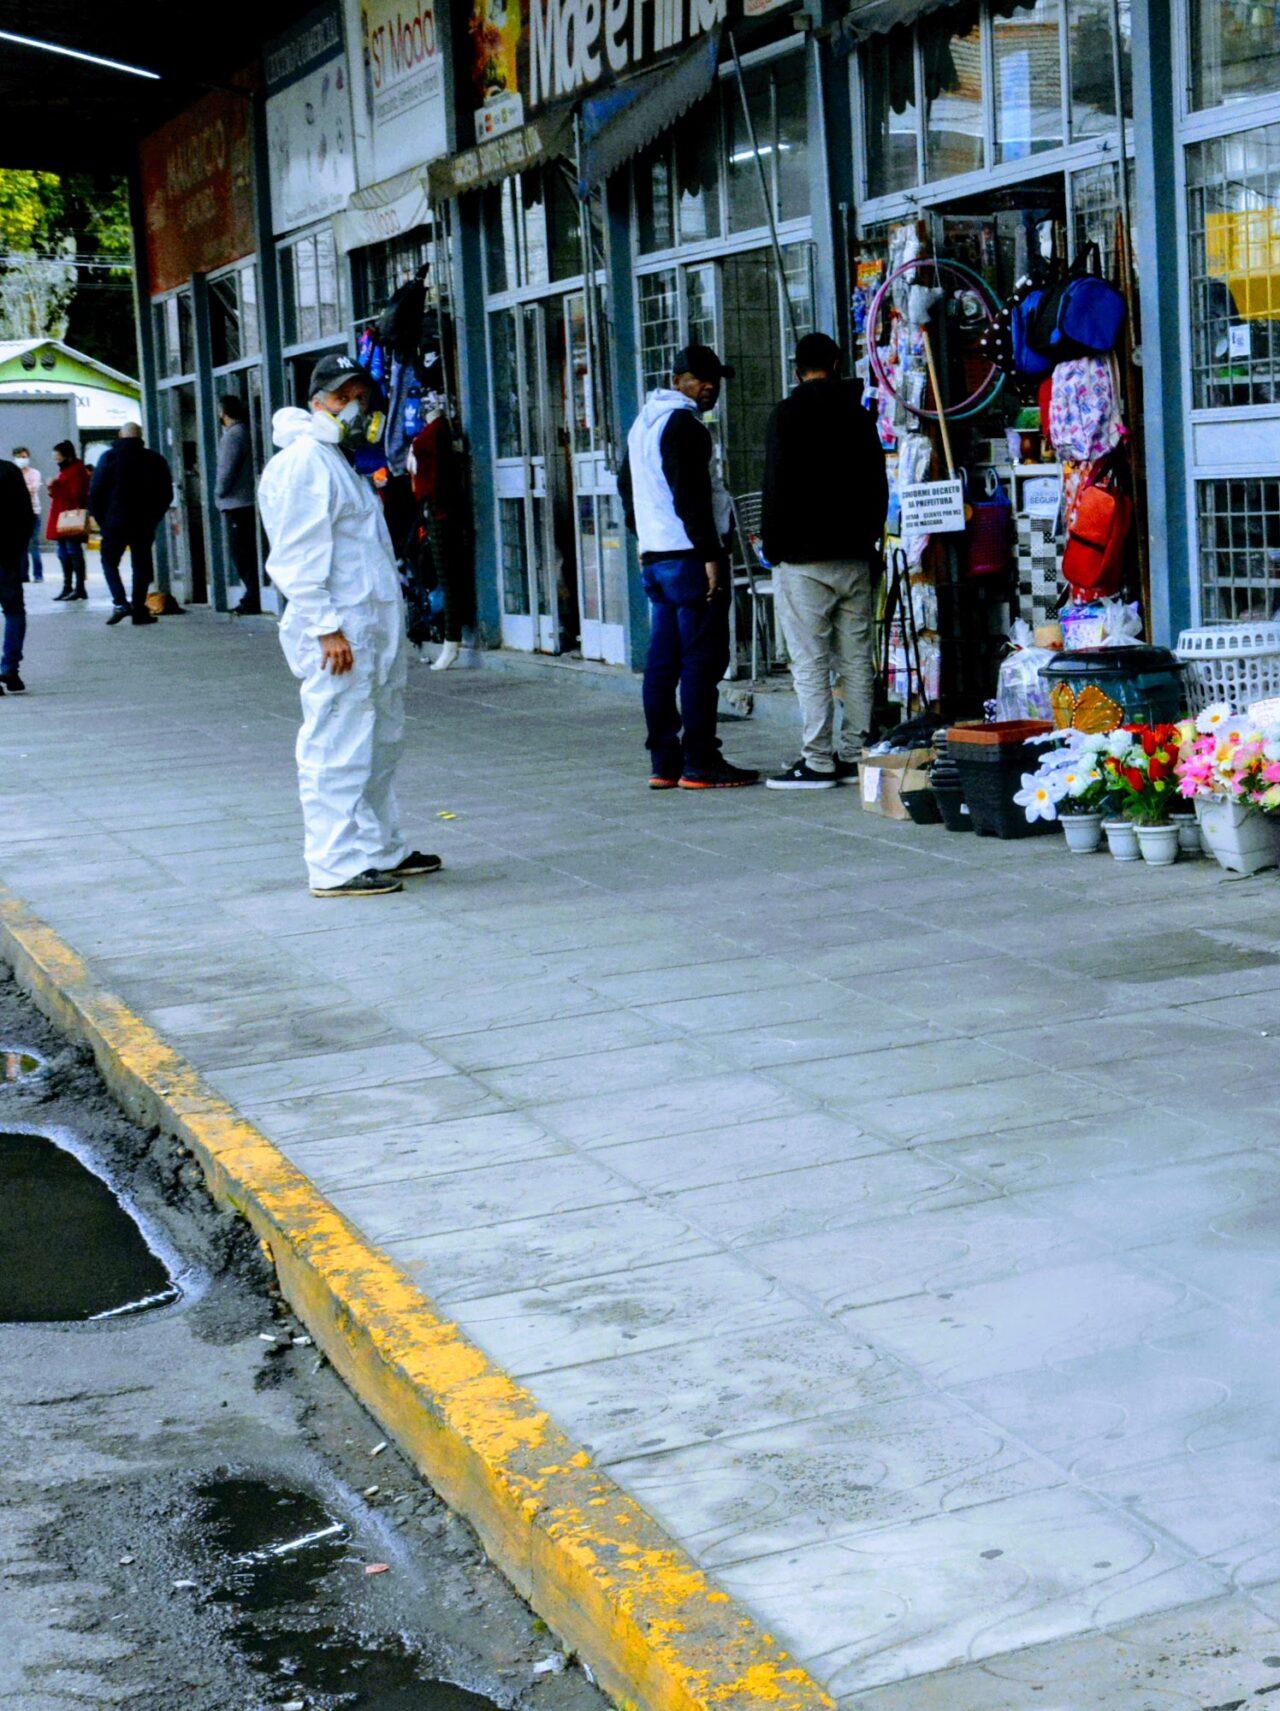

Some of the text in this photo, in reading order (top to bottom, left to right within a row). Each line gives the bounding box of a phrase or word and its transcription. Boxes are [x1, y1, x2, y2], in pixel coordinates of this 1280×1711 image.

[388, 0, 437, 80] Moda
[931, 485, 960, 496] DECRETO
[915, 497, 953, 508] PREFEITURA
